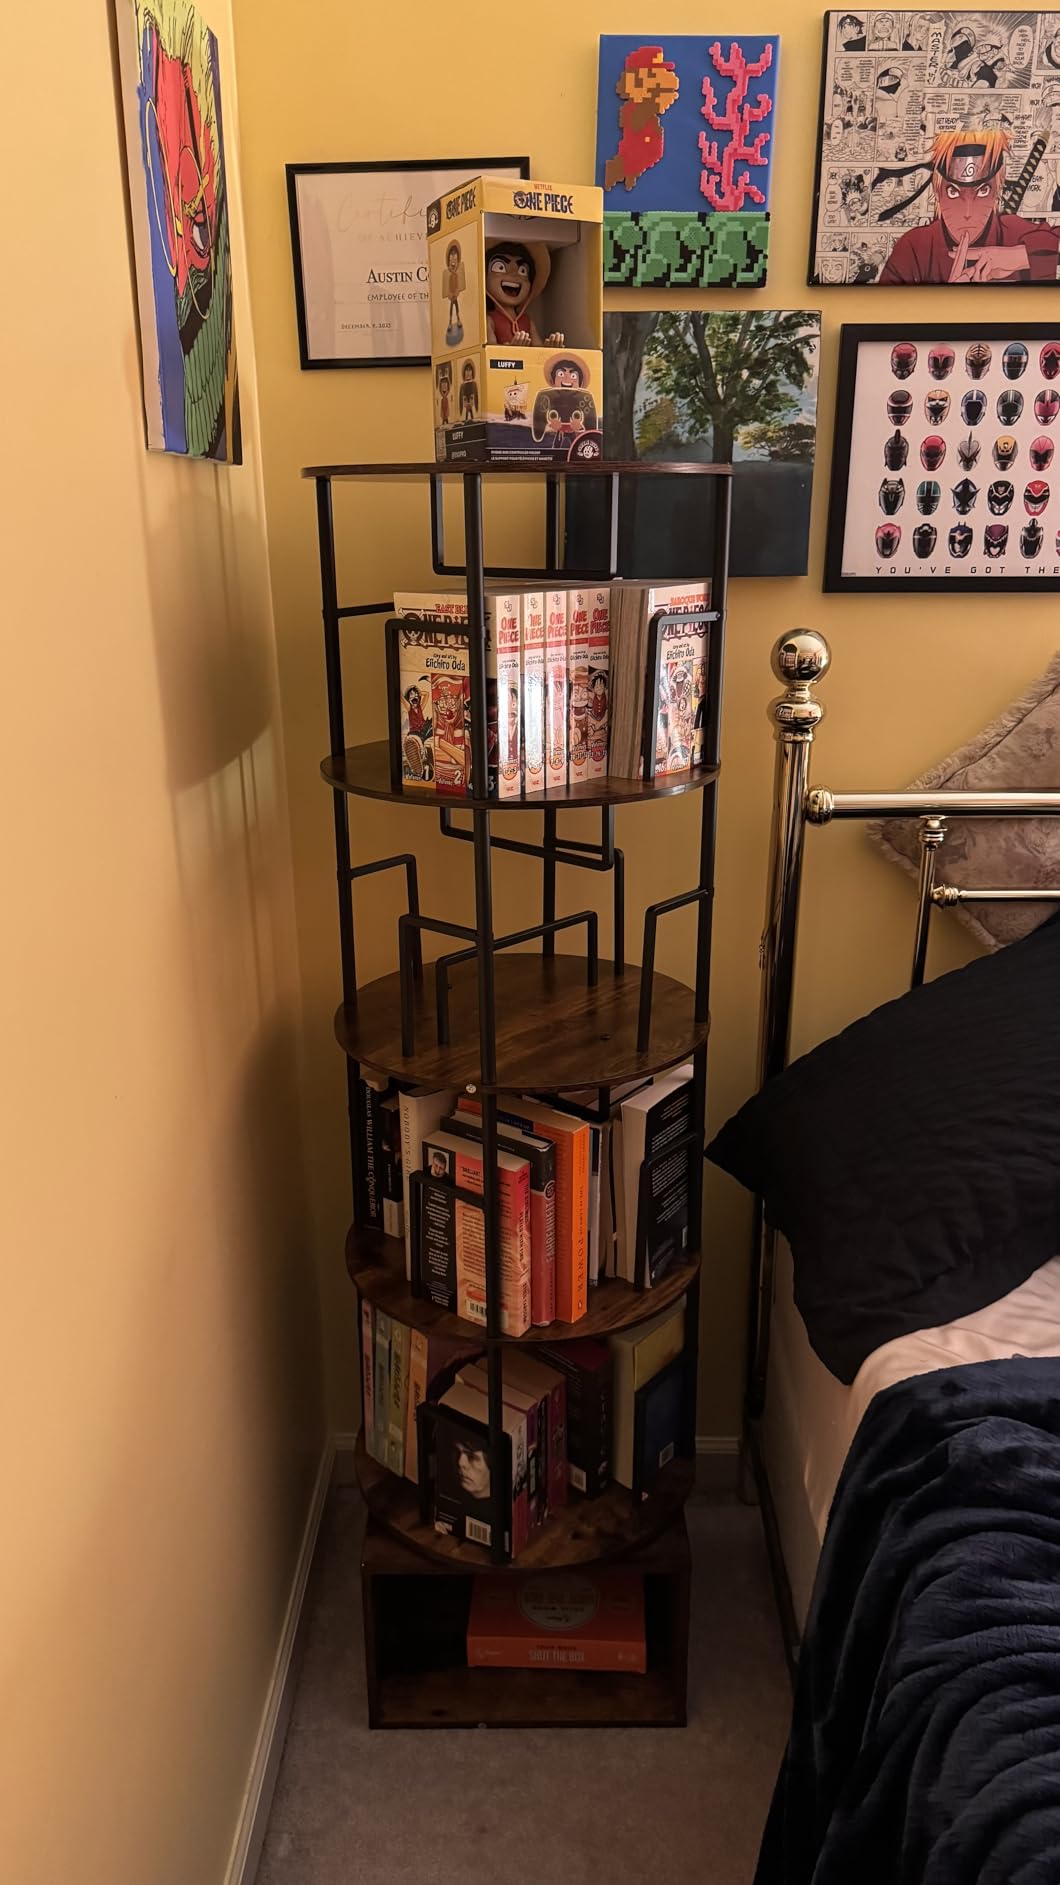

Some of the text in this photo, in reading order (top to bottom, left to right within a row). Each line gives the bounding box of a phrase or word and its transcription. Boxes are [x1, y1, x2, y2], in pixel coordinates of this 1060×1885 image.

[533, 183, 553, 192] NETFLIX
[446, 186, 477, 220] ONE PIECE
[512, 190, 575, 215] ONE PIECE
[366, 266, 430, 284] AUSTIN C
[367, 292, 429, 301] EMPLOYEE OF TH
[497, 361, 516, 369] LUFFY
[875, 566, 1060, 575] YOU'VE GOT THE
[549, 611, 564, 626] ONE
[573, 610, 588, 623] ONE
[593, 608, 609, 622] ONE
[501, 616, 517, 631] ONE
[570, 622, 589, 637] PIECE
[590, 621, 610, 635] PIECE
[498, 630, 519, 645] PIECE
[547, 624, 567, 639] PIECE
[685, 647, 695, 657] Oda
[425, 657, 466, 672] Eiichiro Oda
[423, 765, 430, 781] 1
[454, 769, 462, 785] 2
[364, 1086, 374, 1118] DOUGLAS
[365, 1118, 377, 1218] WILLIAM THE CONQUEROR
[577, 1237, 585, 1293] POWER
